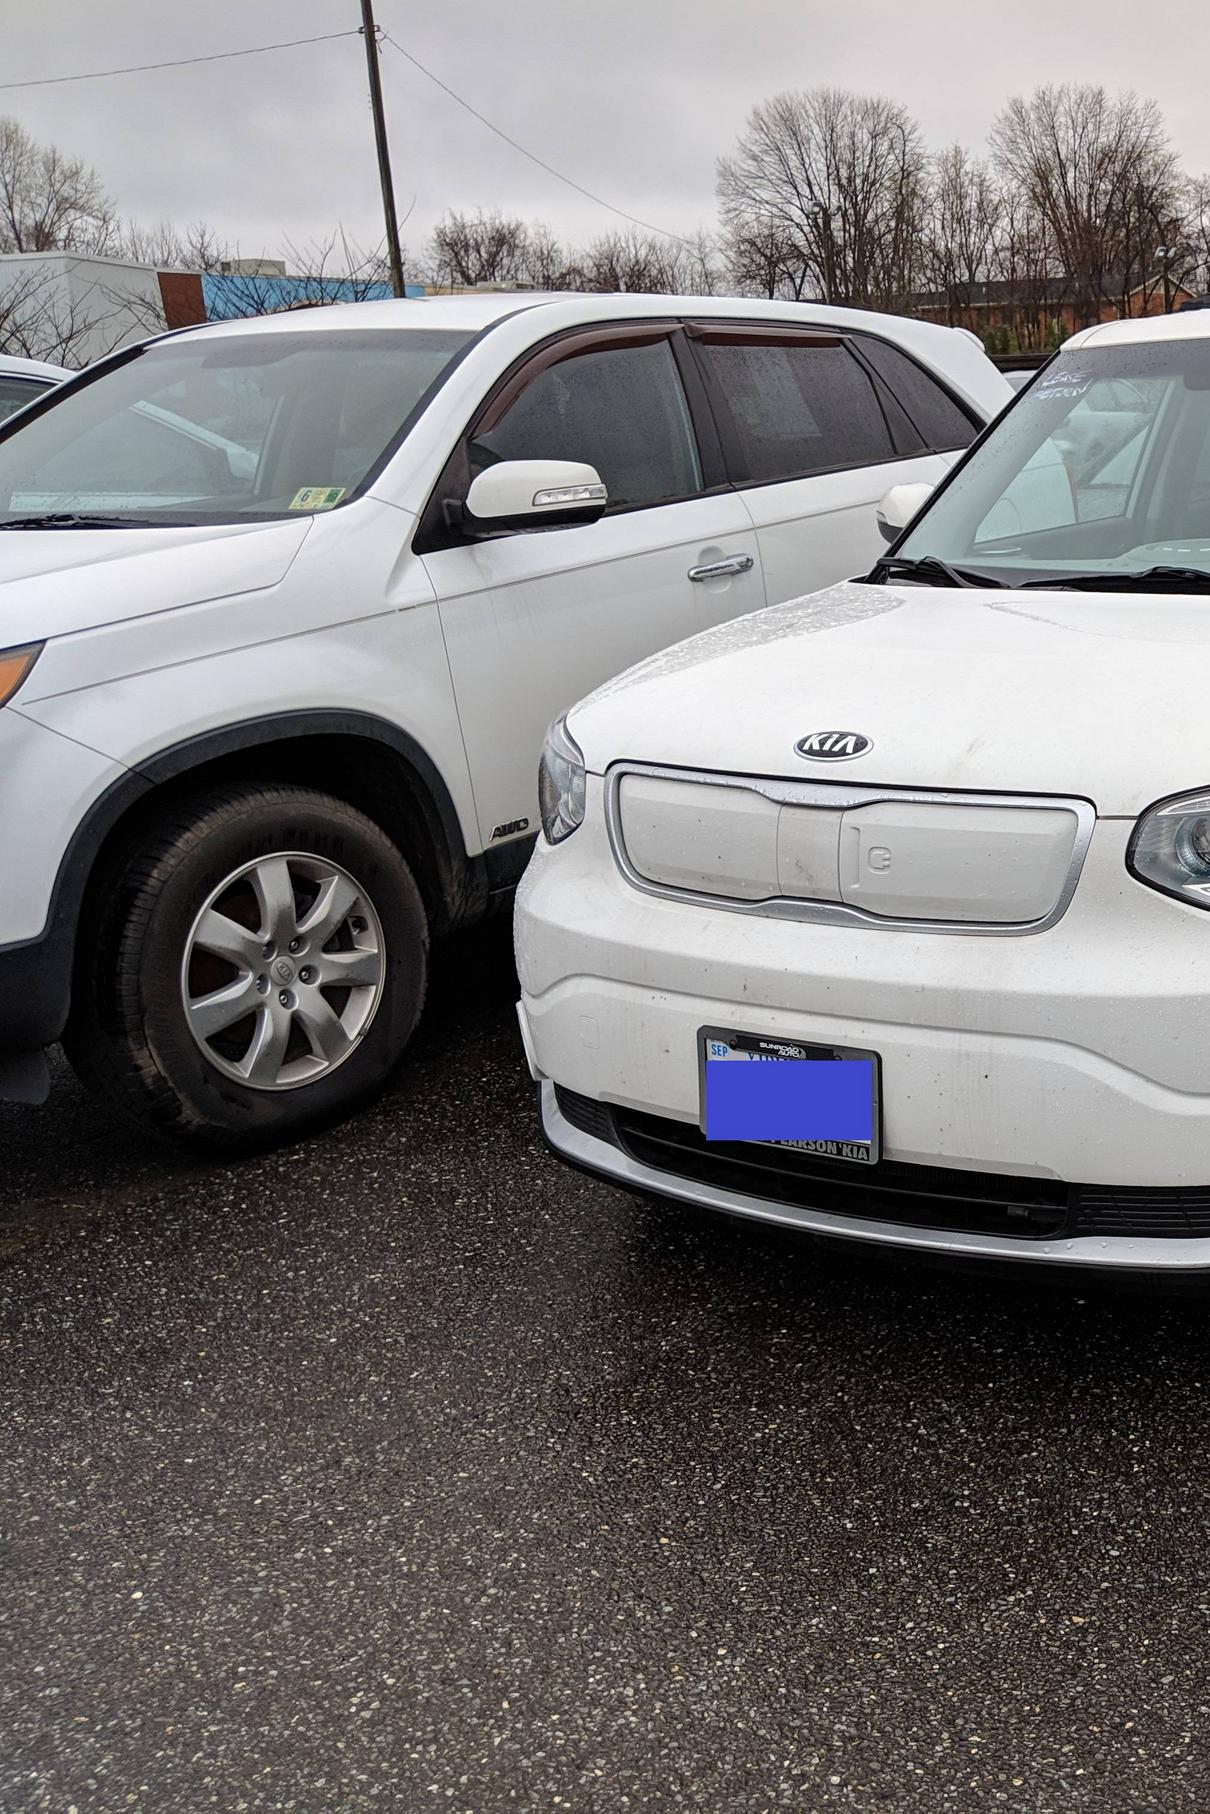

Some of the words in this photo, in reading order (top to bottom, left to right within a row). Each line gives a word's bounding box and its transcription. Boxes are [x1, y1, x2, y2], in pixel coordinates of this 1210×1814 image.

[802, 733, 857, 754] KIA
[711, 1043, 728, 1057] SEP
[759, 1042, 799, 1053] SUNROAD
[778, 1050, 800, 1058] AUTO
[771, 1140, 837, 1154] ARSON
